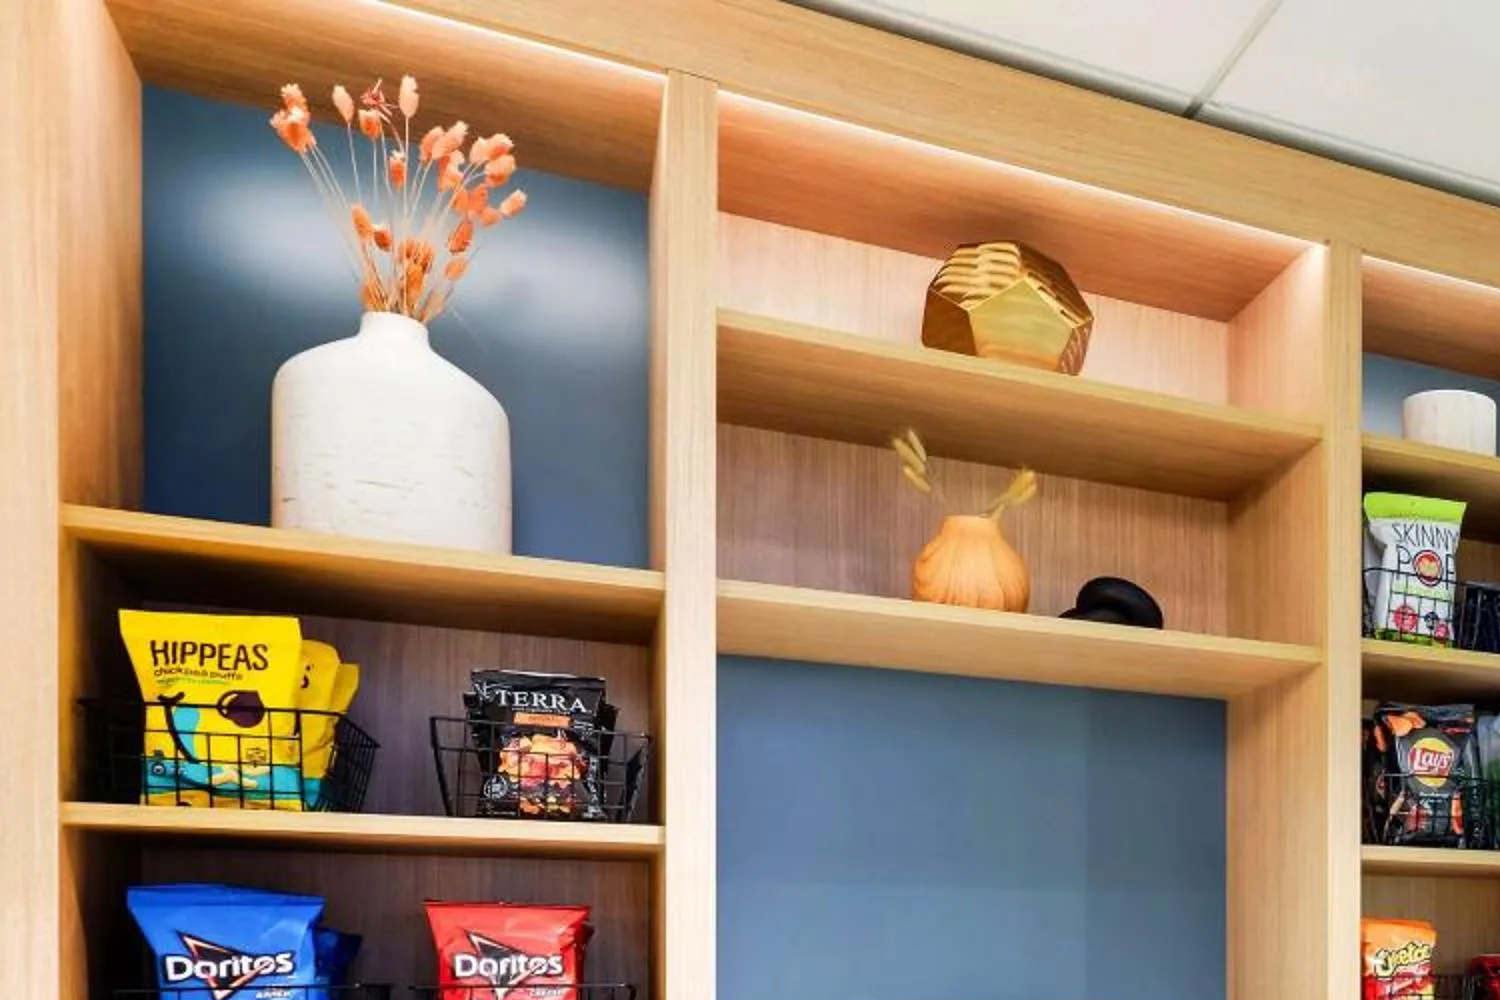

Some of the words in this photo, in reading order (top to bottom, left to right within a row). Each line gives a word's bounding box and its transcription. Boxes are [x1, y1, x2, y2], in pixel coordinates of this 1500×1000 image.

[150, 639, 269, 671] HIPPEAS
[495, 689, 587, 713] TERRA
[164, 952, 295, 982] Doritos
[454, 953, 564, 979] Doritos
